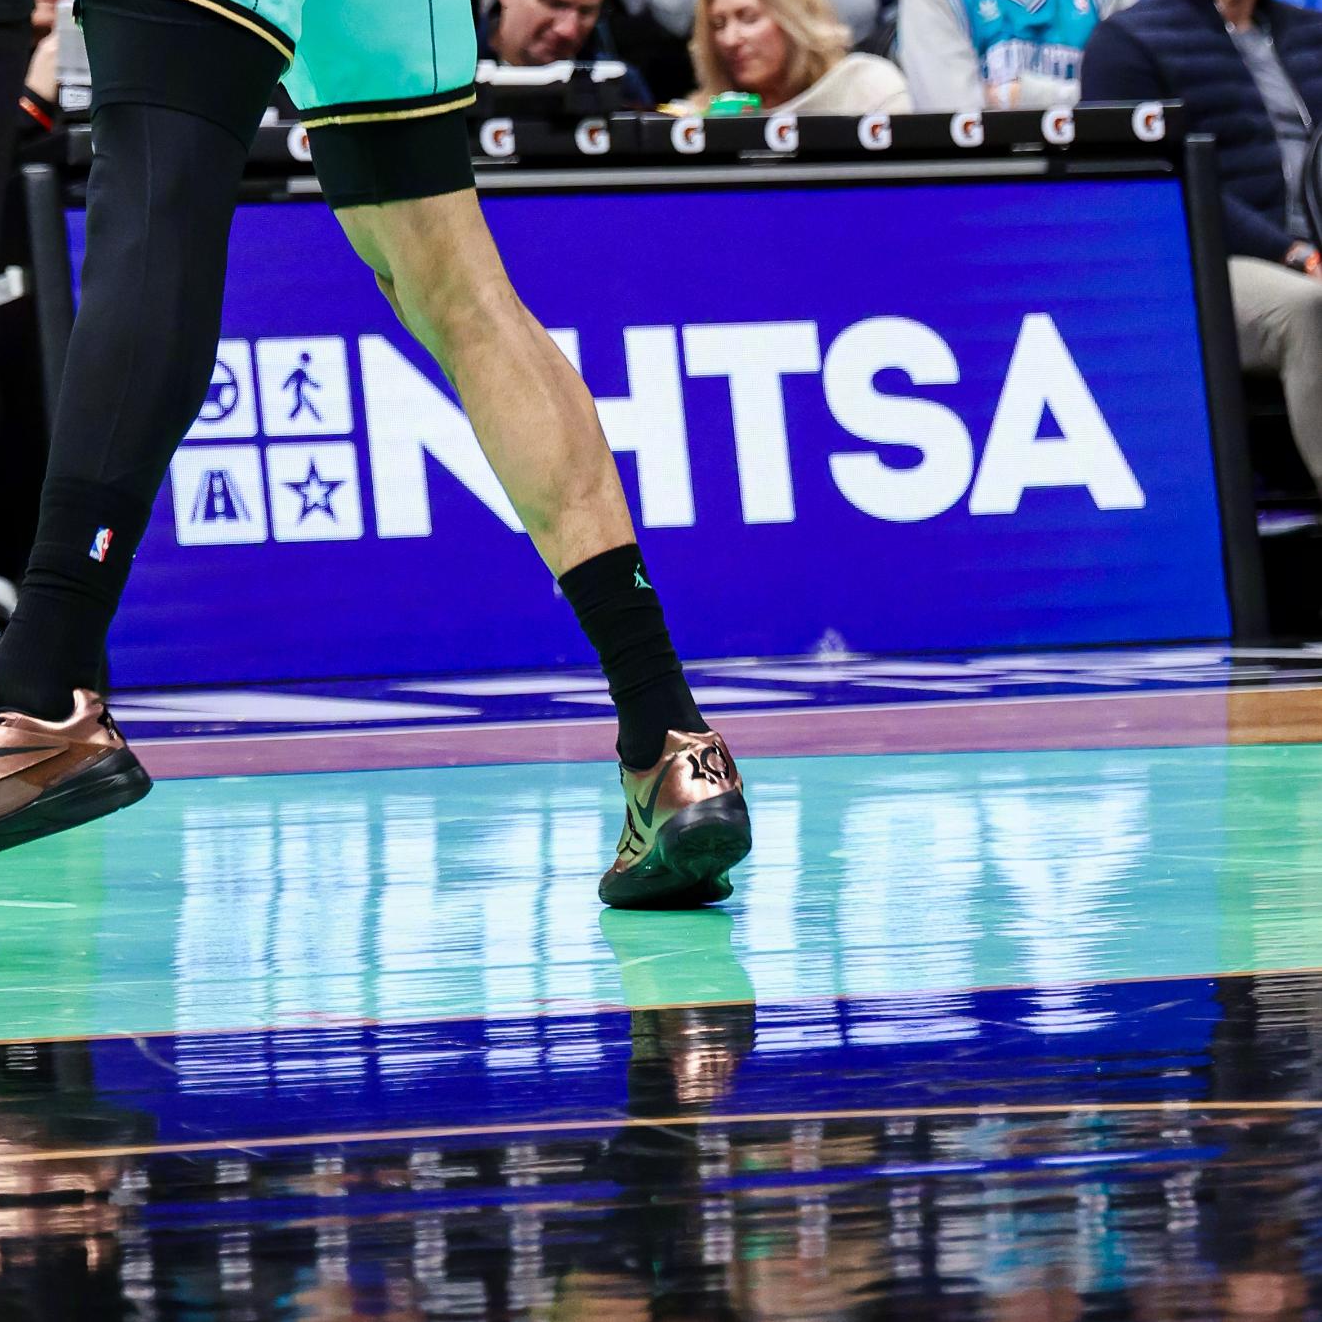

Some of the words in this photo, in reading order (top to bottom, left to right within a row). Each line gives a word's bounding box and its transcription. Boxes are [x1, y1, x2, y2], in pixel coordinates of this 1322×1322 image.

[480, 118, 515, 157] G
[575, 118, 610, 155] G
[670, 115, 705, 154] G
[764, 112, 799, 152] G
[857, 111, 892, 150] G
[950, 109, 984, 148] G
[1041, 105, 1075, 144] G
[1131, 101, 1166, 142] G
[359, 312, 1146, 538] NHTSA
